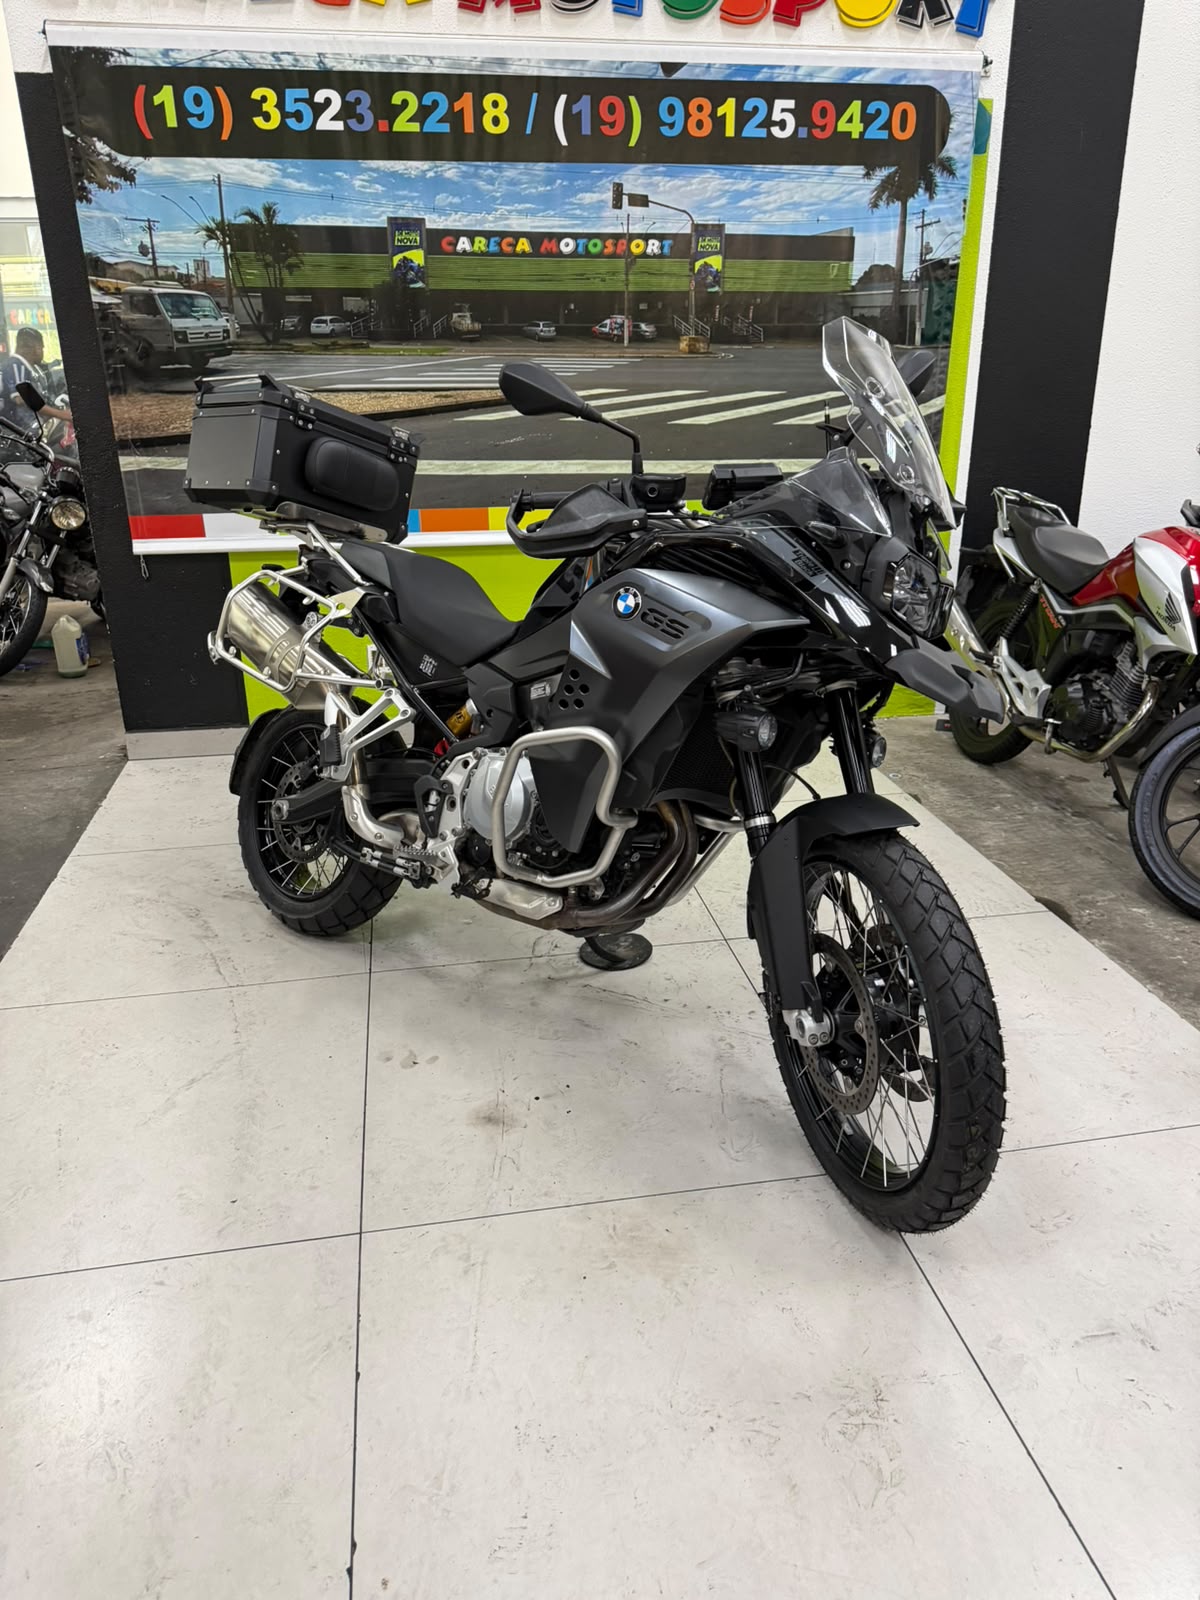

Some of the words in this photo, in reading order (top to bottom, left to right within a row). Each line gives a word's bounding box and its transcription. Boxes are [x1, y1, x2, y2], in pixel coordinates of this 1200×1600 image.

[134, 84, 233, 141] (19)
[250, 87, 510, 136] 3523.2218
[525, 92, 538, 136] /
[554, 93, 642, 147] (19)
[658, 96, 917, 142] 98125.9420
[396, 236, 419, 245] NOVA
[440, 236, 533, 254] CARECA
[539, 237, 673, 256] MOTOSPORT
[699, 242, 719, 251] NOVA
[641, 608, 690, 640] GS
[1155, 610, 1176, 632] HONDA
